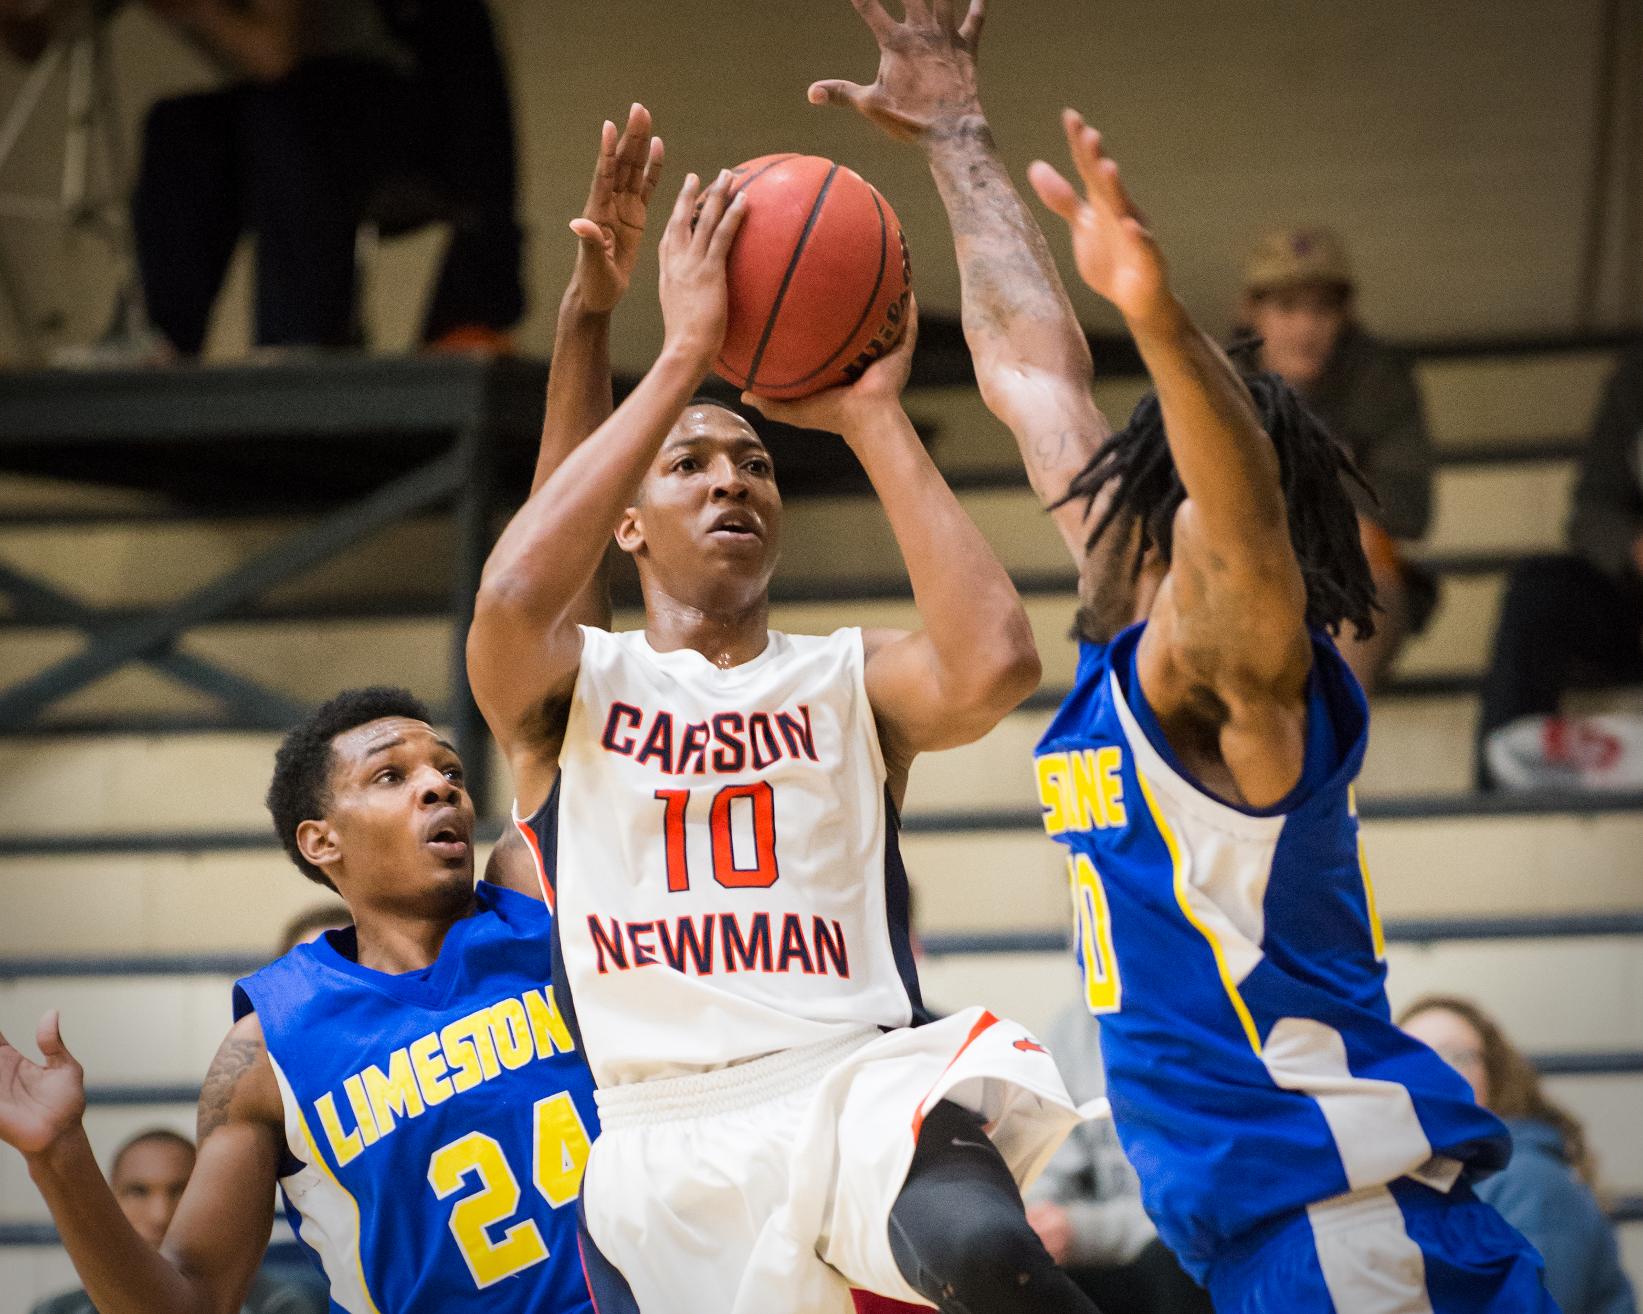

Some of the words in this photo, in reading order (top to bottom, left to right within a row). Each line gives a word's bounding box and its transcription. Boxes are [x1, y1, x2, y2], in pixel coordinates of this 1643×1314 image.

[600, 701, 820, 775] CARSON
[654, 780, 779, 893] 10
[586, 912, 850, 979] NEWMAN
[313, 985, 575, 1168] LIMESTON
[427, 1090, 591, 1290] 24
